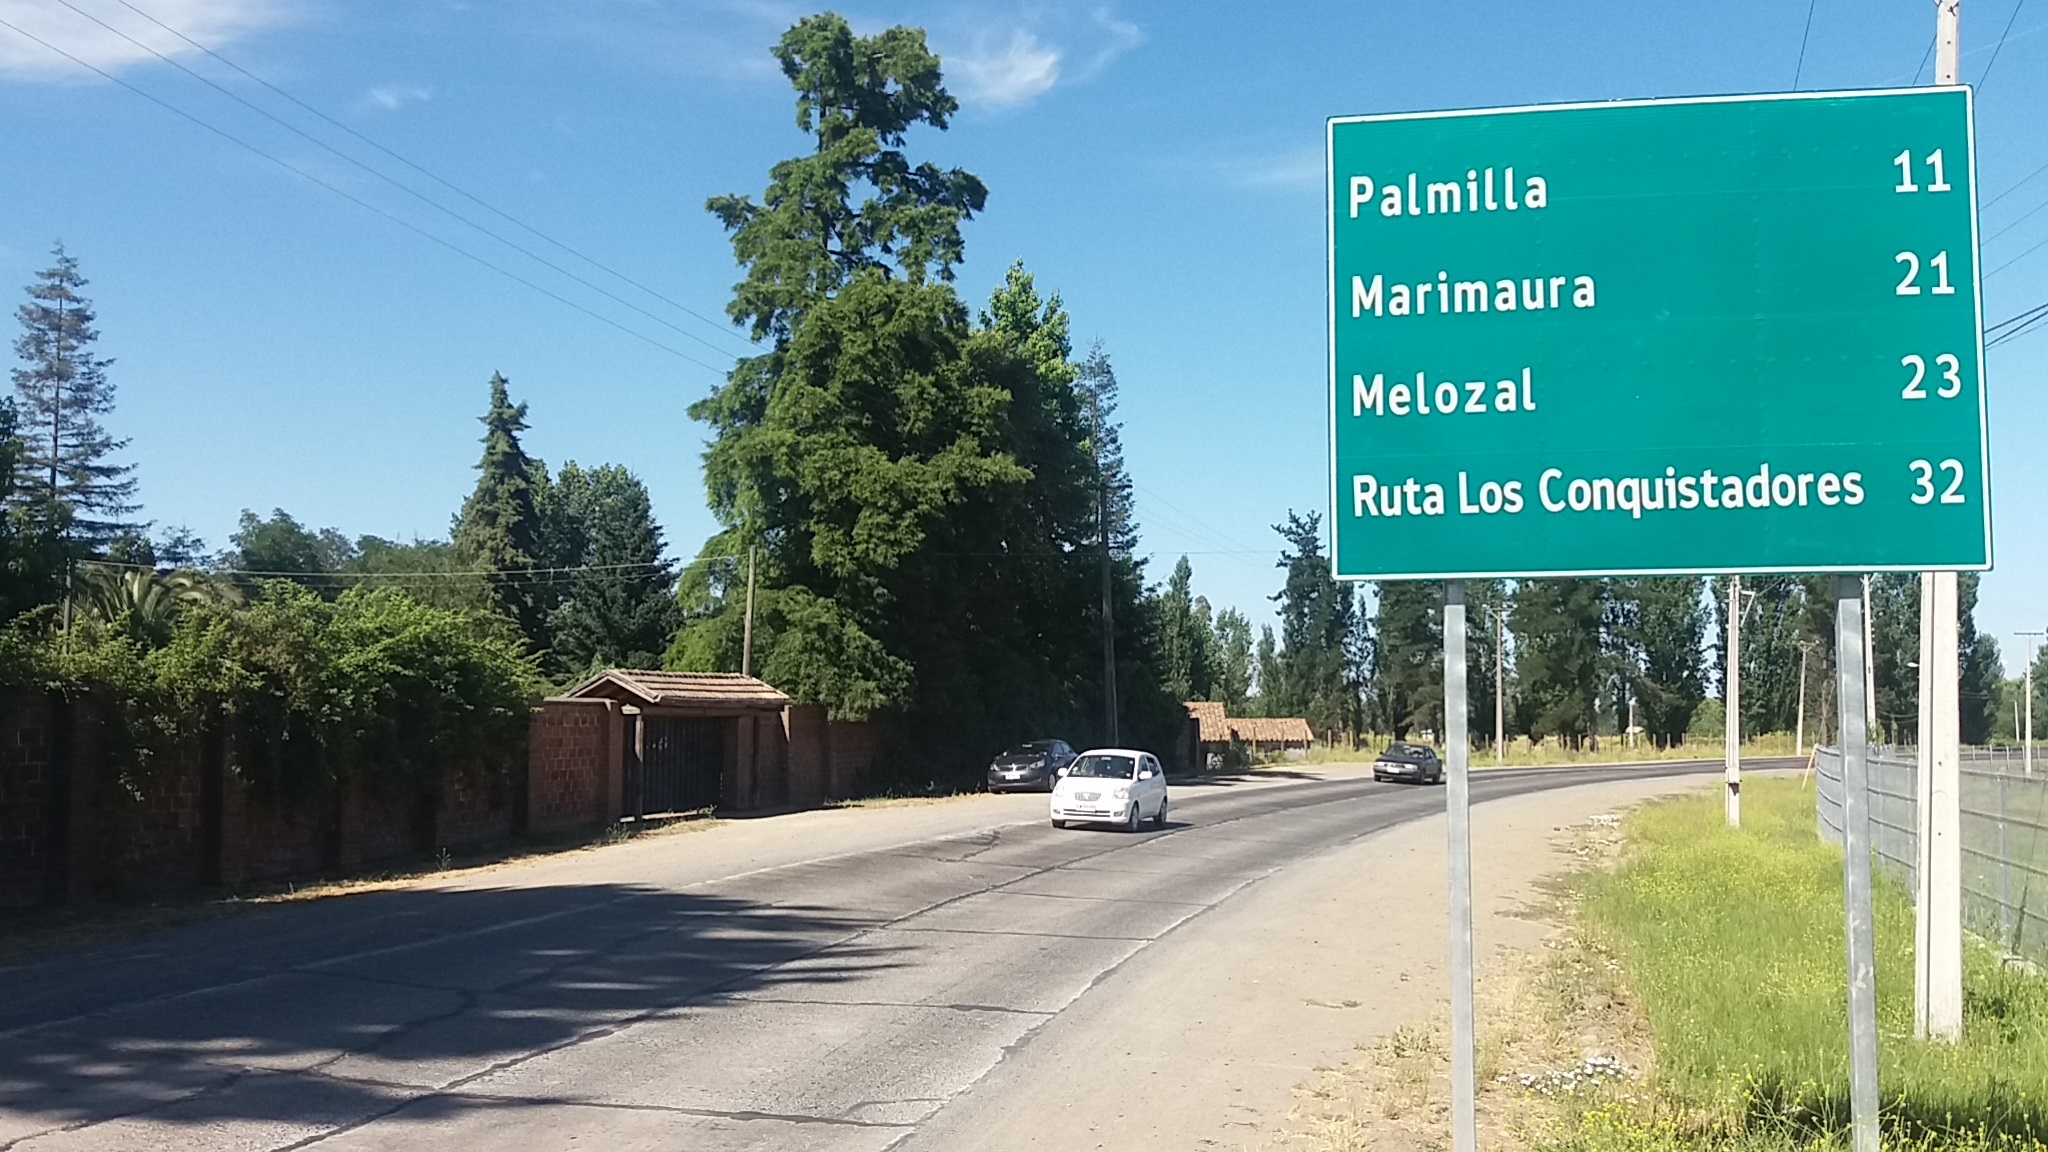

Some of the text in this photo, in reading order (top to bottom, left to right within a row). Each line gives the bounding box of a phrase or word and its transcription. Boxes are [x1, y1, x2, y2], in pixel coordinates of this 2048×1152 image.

[1349, 148, 1952, 218] Palmilla 11
[1351, 250, 1956, 318] Marimaura 21
[1352, 353, 1962, 417] Melozal 23
[1353, 458, 1967, 519] Ruta Los Conquistadores 32
